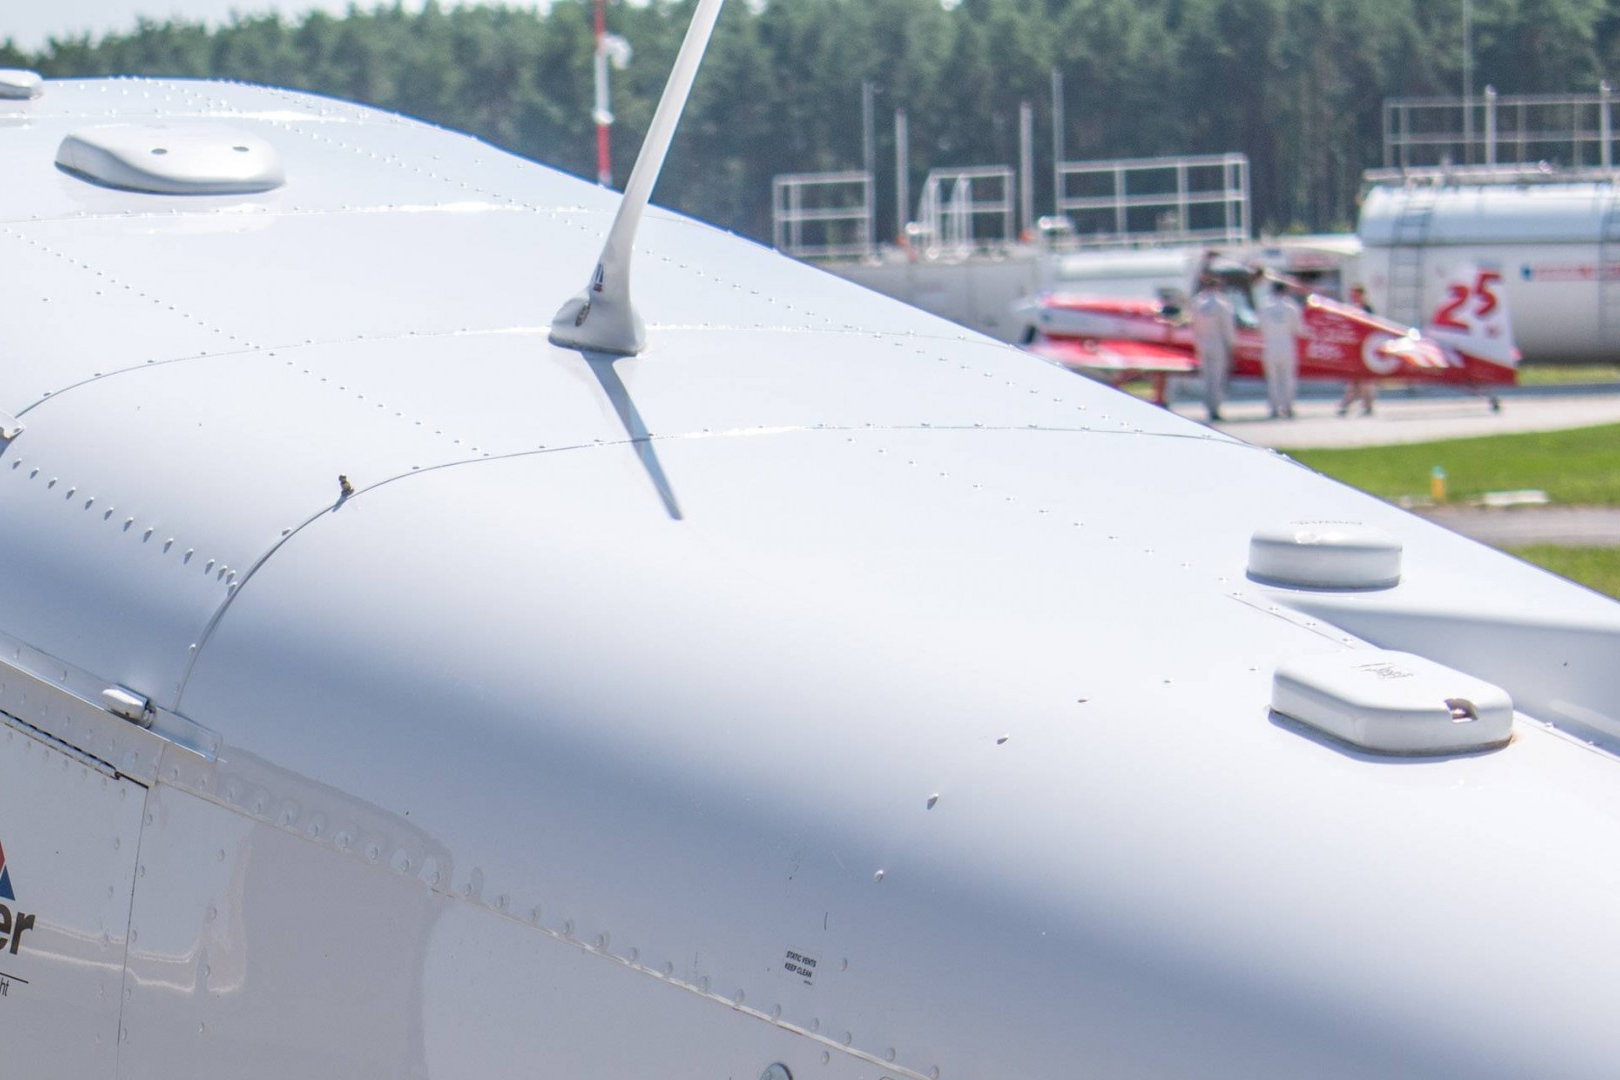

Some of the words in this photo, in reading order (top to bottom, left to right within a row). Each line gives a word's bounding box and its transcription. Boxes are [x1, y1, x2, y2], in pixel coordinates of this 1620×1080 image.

[1433, 270, 1502, 330] 25
[786, 950, 802, 962] STATIC
[802, 956, 817, 968] VENTS
[784, 962, 797, 972] KEEP
[796, 967, 813, 978] CLEAN
